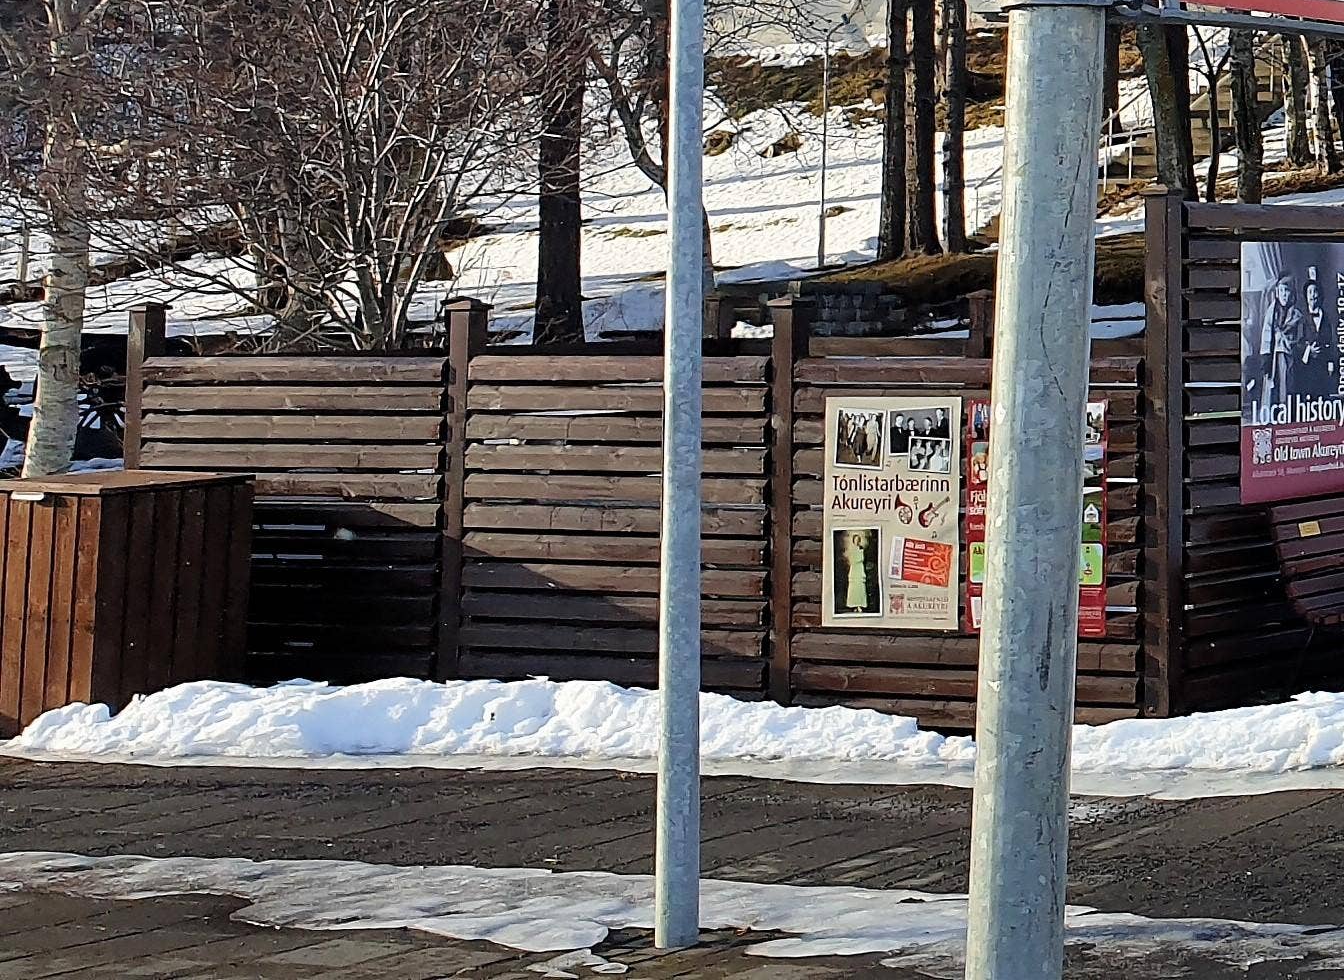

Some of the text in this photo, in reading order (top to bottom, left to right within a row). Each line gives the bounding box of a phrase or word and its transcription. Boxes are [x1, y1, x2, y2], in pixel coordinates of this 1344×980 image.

[1252, 394, 1292, 426] Local
[1274, 445, 1289, 462] Old
[832, 474, 950, 492] Tónlistarbærinn
[832, 493, 892, 514] Akureyri
